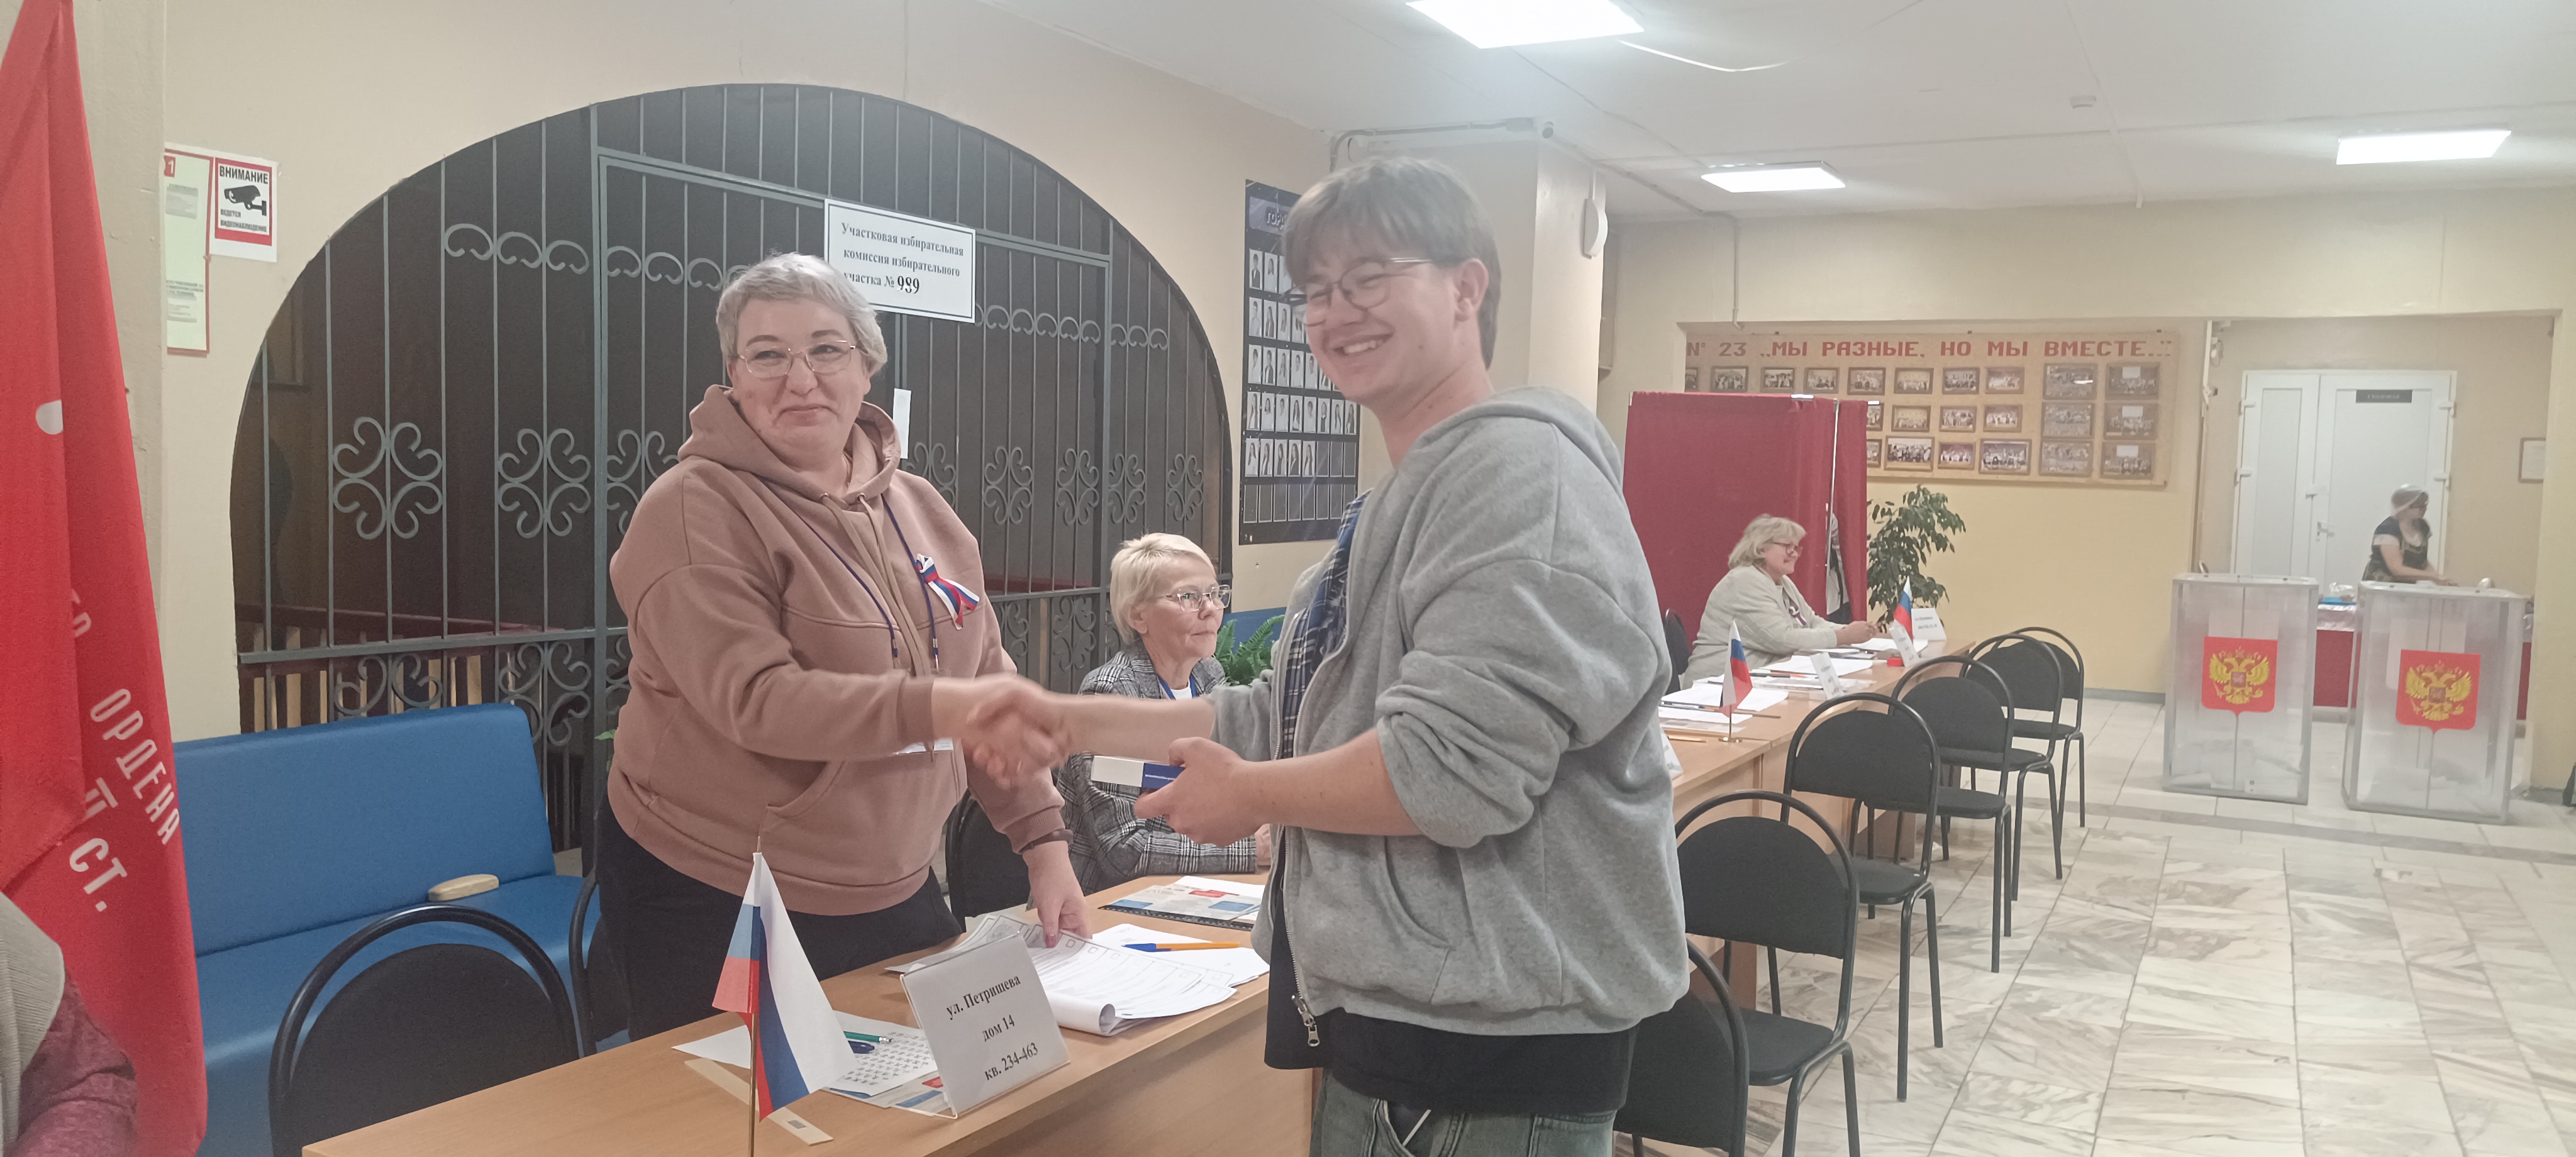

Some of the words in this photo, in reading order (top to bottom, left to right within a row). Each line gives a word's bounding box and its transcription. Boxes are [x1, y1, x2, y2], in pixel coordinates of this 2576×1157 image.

[219, 165, 269, 185] ВНИМАНИЕ
[841, 223, 898, 243] Участковая
[900, 236, 964, 257] избирательная
[843, 249, 890, 265] комиссия
[892, 257, 960, 277] избирательного
[884, 275, 895, 288] №
[897, 275, 919, 294] 989
[1718, 341, 1747, 357] 23
[1940, 341, 1972, 357] НО
[1987, 341, 2028, 357] МЫ
[90, 688, 180, 845] ОРДЕНА
[69, 838, 128, 912] СТ.
[946, 1002, 963, 1021] ул.
[963, 976, 1021, 1009] Петрищева
[982, 1024, 1002, 1042] дом
[1002, 1014, 1015, 1029] 14
[984, 1066, 1002, 1081] кв.
[1001, 1043, 1038, 1071] 234-463
